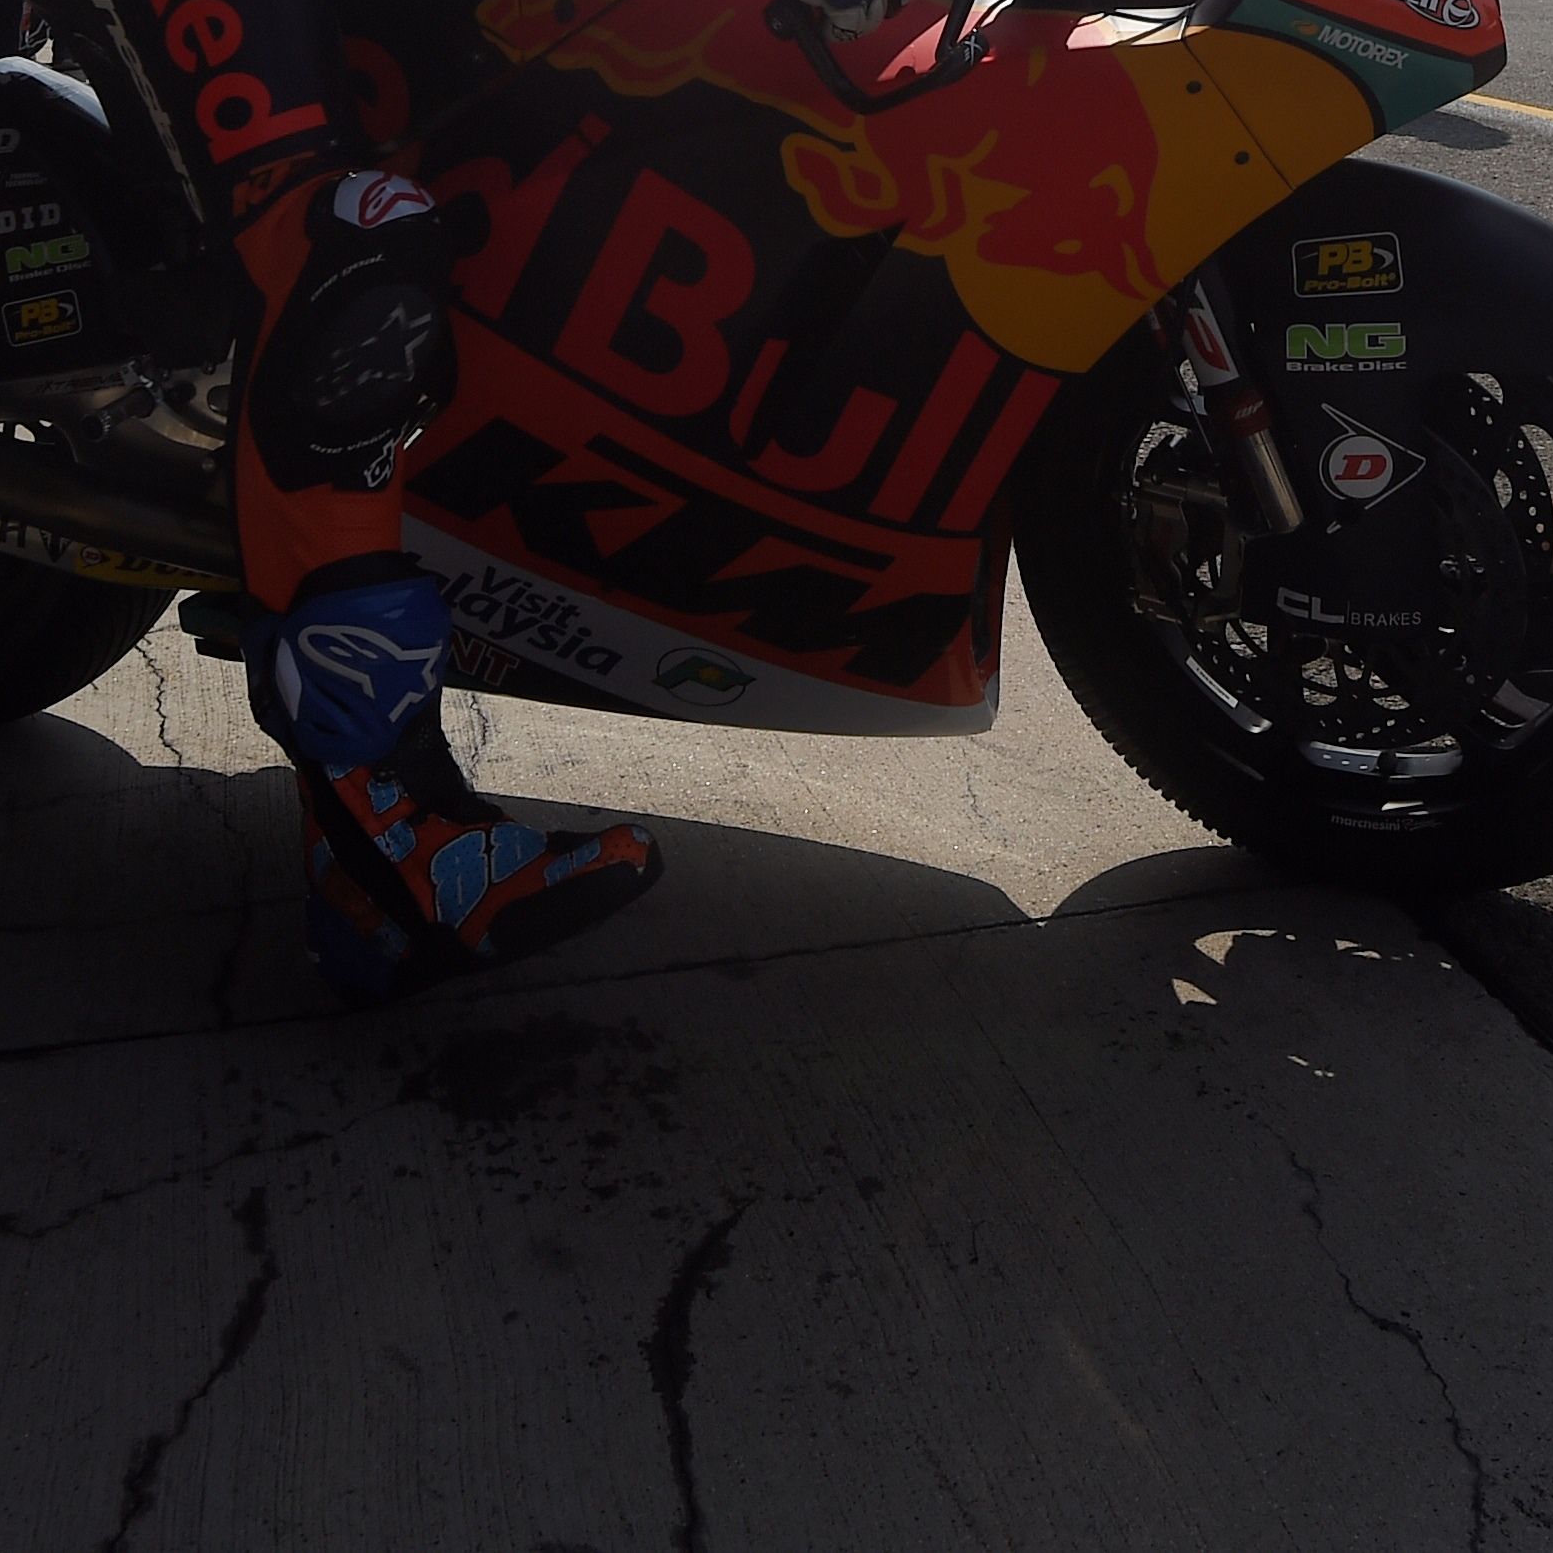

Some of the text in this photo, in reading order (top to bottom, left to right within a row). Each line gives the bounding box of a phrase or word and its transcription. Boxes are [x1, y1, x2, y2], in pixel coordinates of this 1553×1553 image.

[1318, 25, 1410, 70] MOTOREX
[4, 233, 90, 275] NG
[56, 259, 93, 275] Disc
[1317, 238, 1375, 276] PB
[20, 296, 61, 328] PB
[552, 163, 1062, 534] Bull
[1286, 322, 1407, 360] NG
[1286, 360, 1407, 373] Brake Disc
[480, 564, 581, 629] Visit
[1277, 585, 1423, 627] CL BRAKES
[440, 572, 624, 677] laysia
[1331, 813, 1400, 832] marchesini
